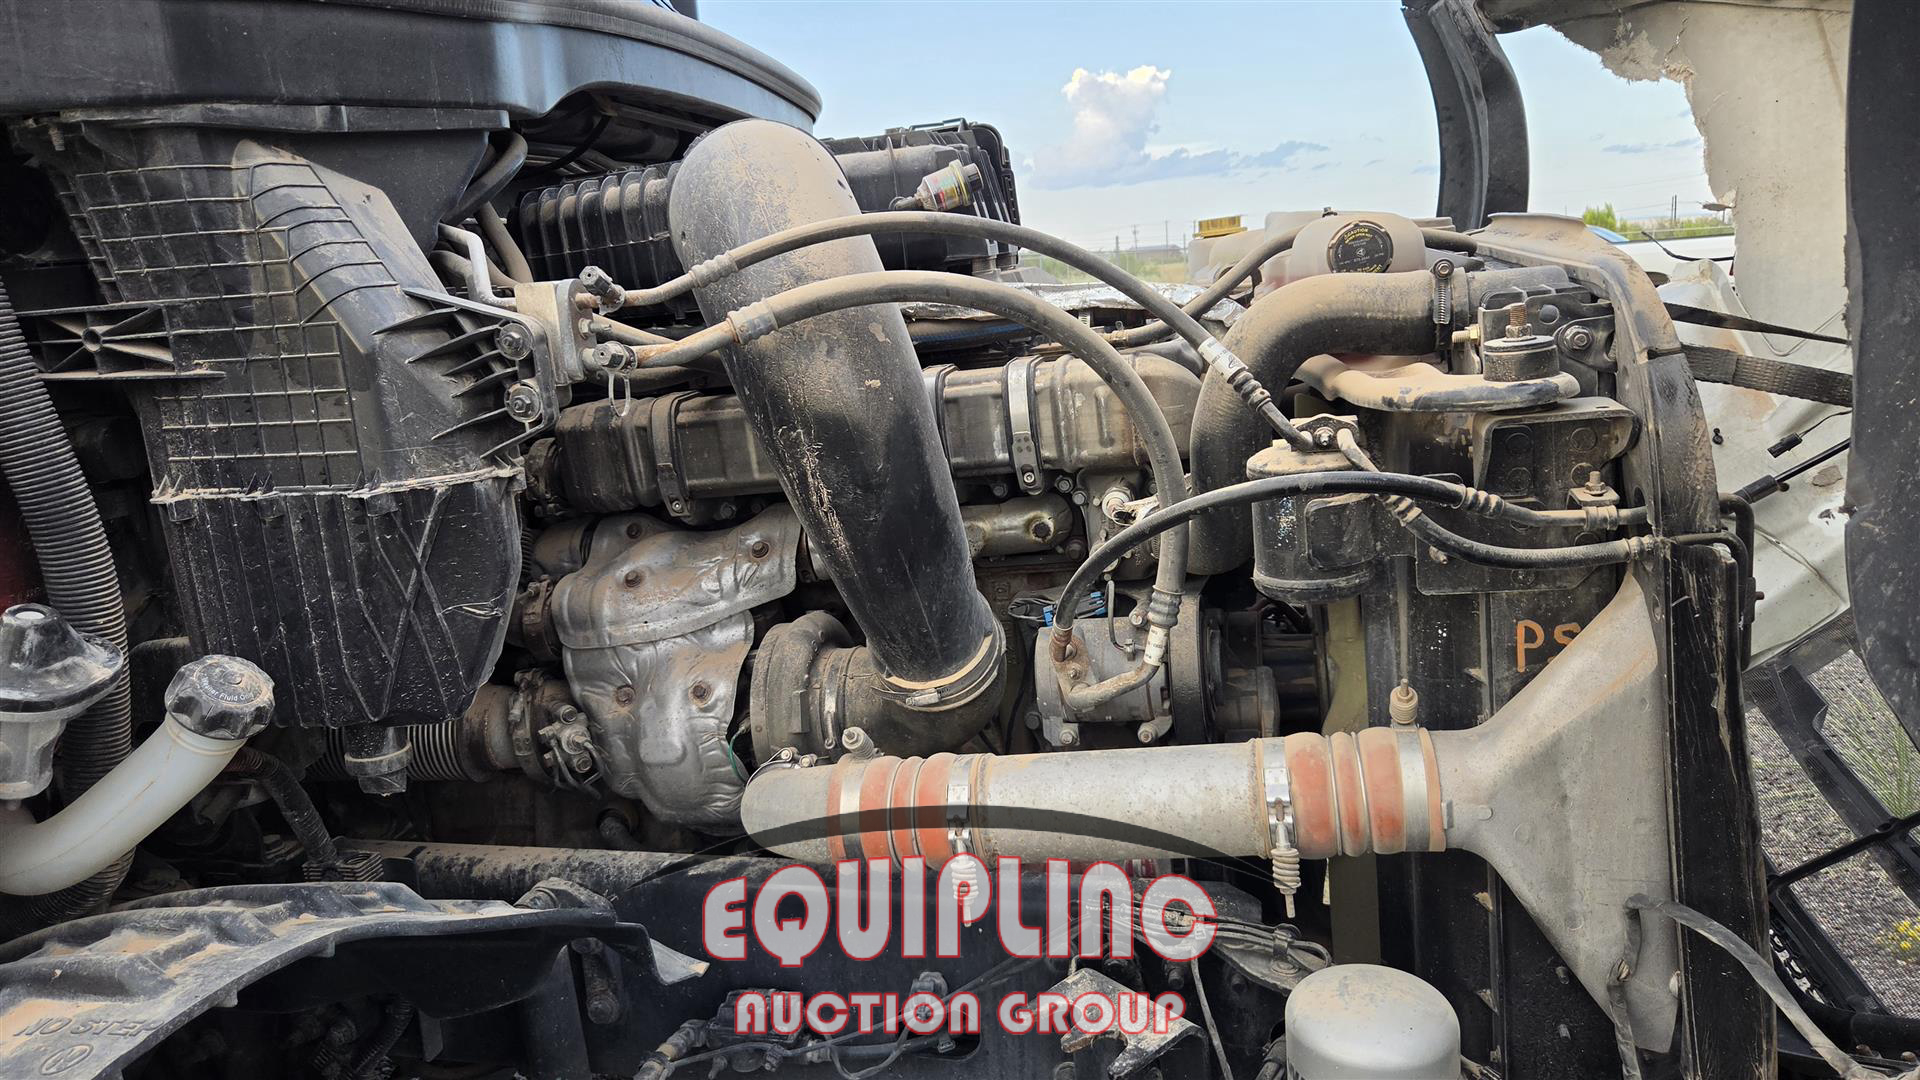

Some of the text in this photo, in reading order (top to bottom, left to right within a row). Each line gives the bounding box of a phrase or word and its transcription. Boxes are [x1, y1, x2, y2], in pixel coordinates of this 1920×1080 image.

[1347, 228, 1369, 236] CAUTION
[219, 692, 238, 701] Fluid
[13, 1016, 165, 1037] NO STEP
